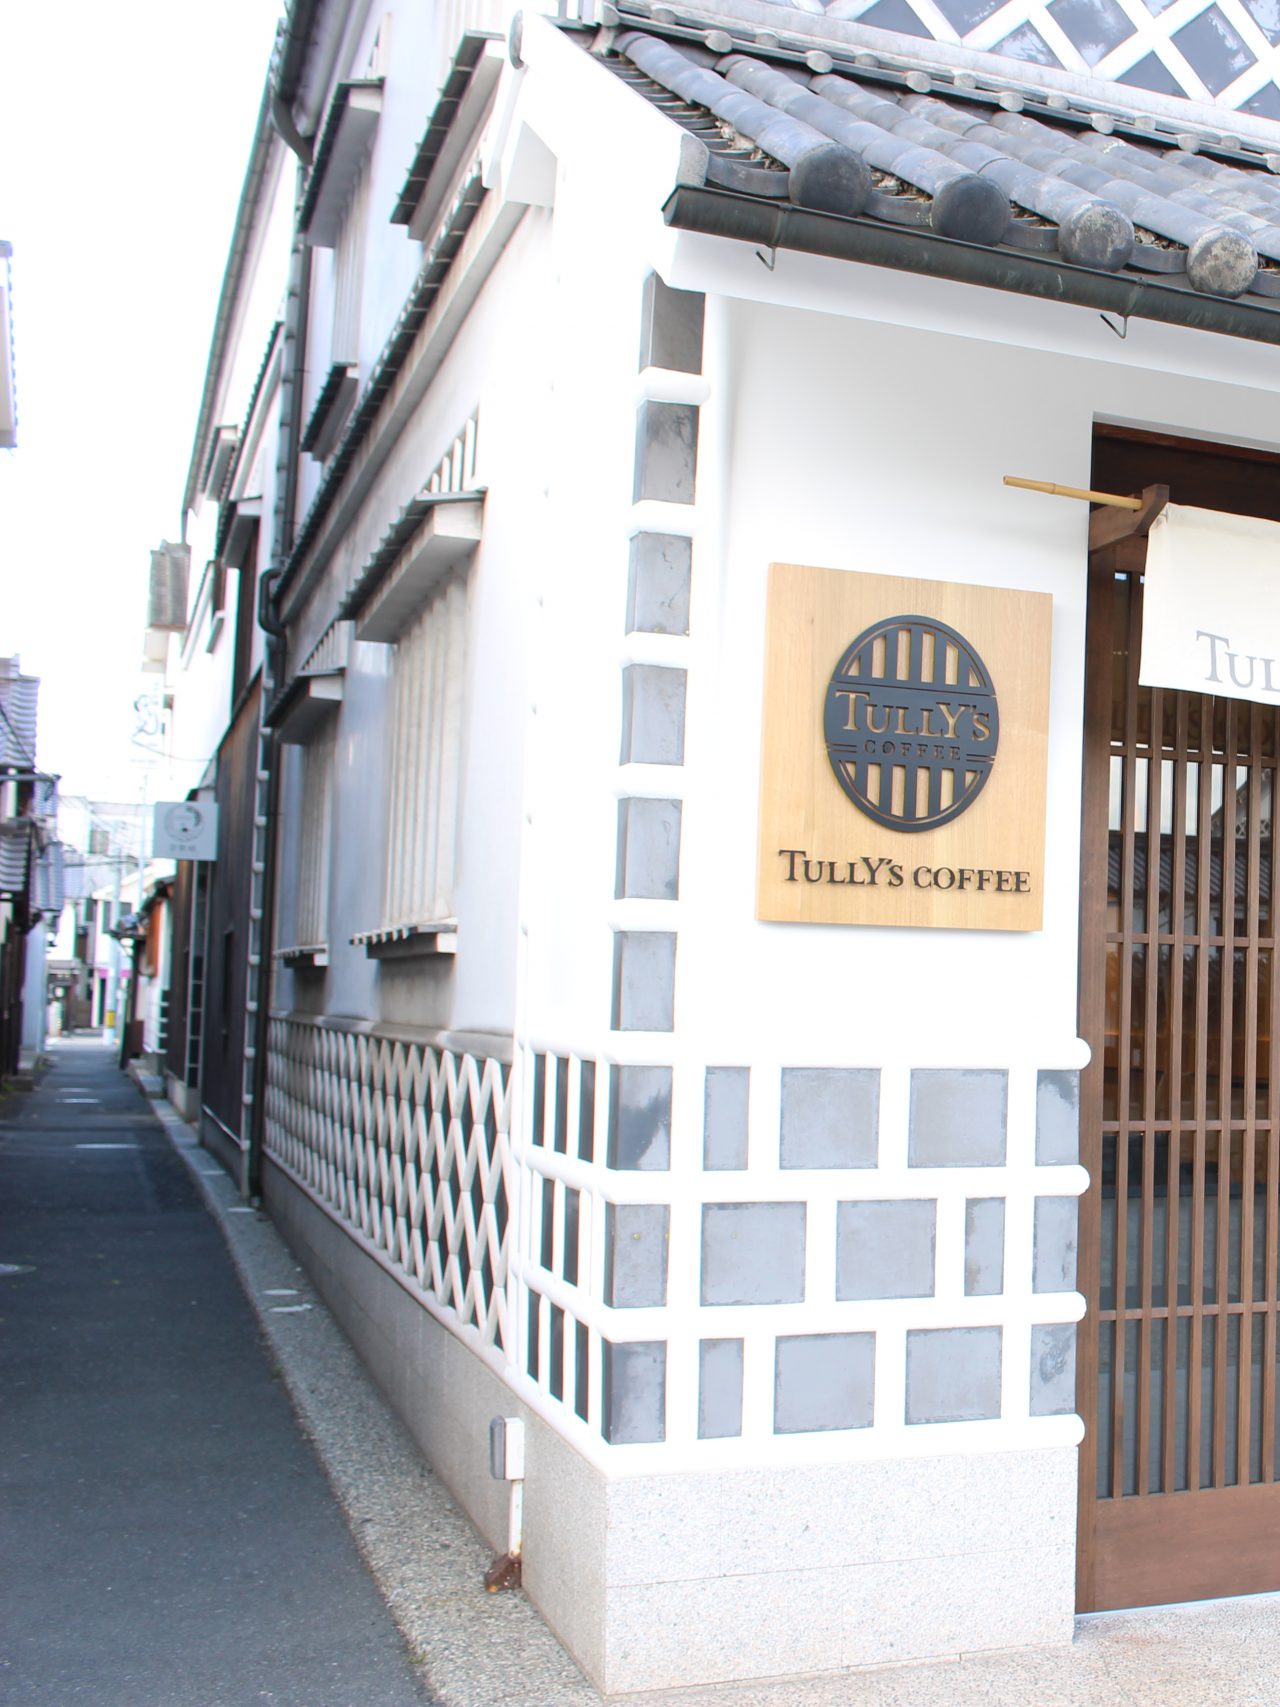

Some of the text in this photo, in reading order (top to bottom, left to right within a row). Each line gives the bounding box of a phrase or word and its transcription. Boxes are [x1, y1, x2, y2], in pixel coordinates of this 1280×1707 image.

[835, 689, 991, 741] TULLY'S
[864, 740, 962, 761] COFFEE
[778, 849, 1032, 894] TULLY'S COFFEE
